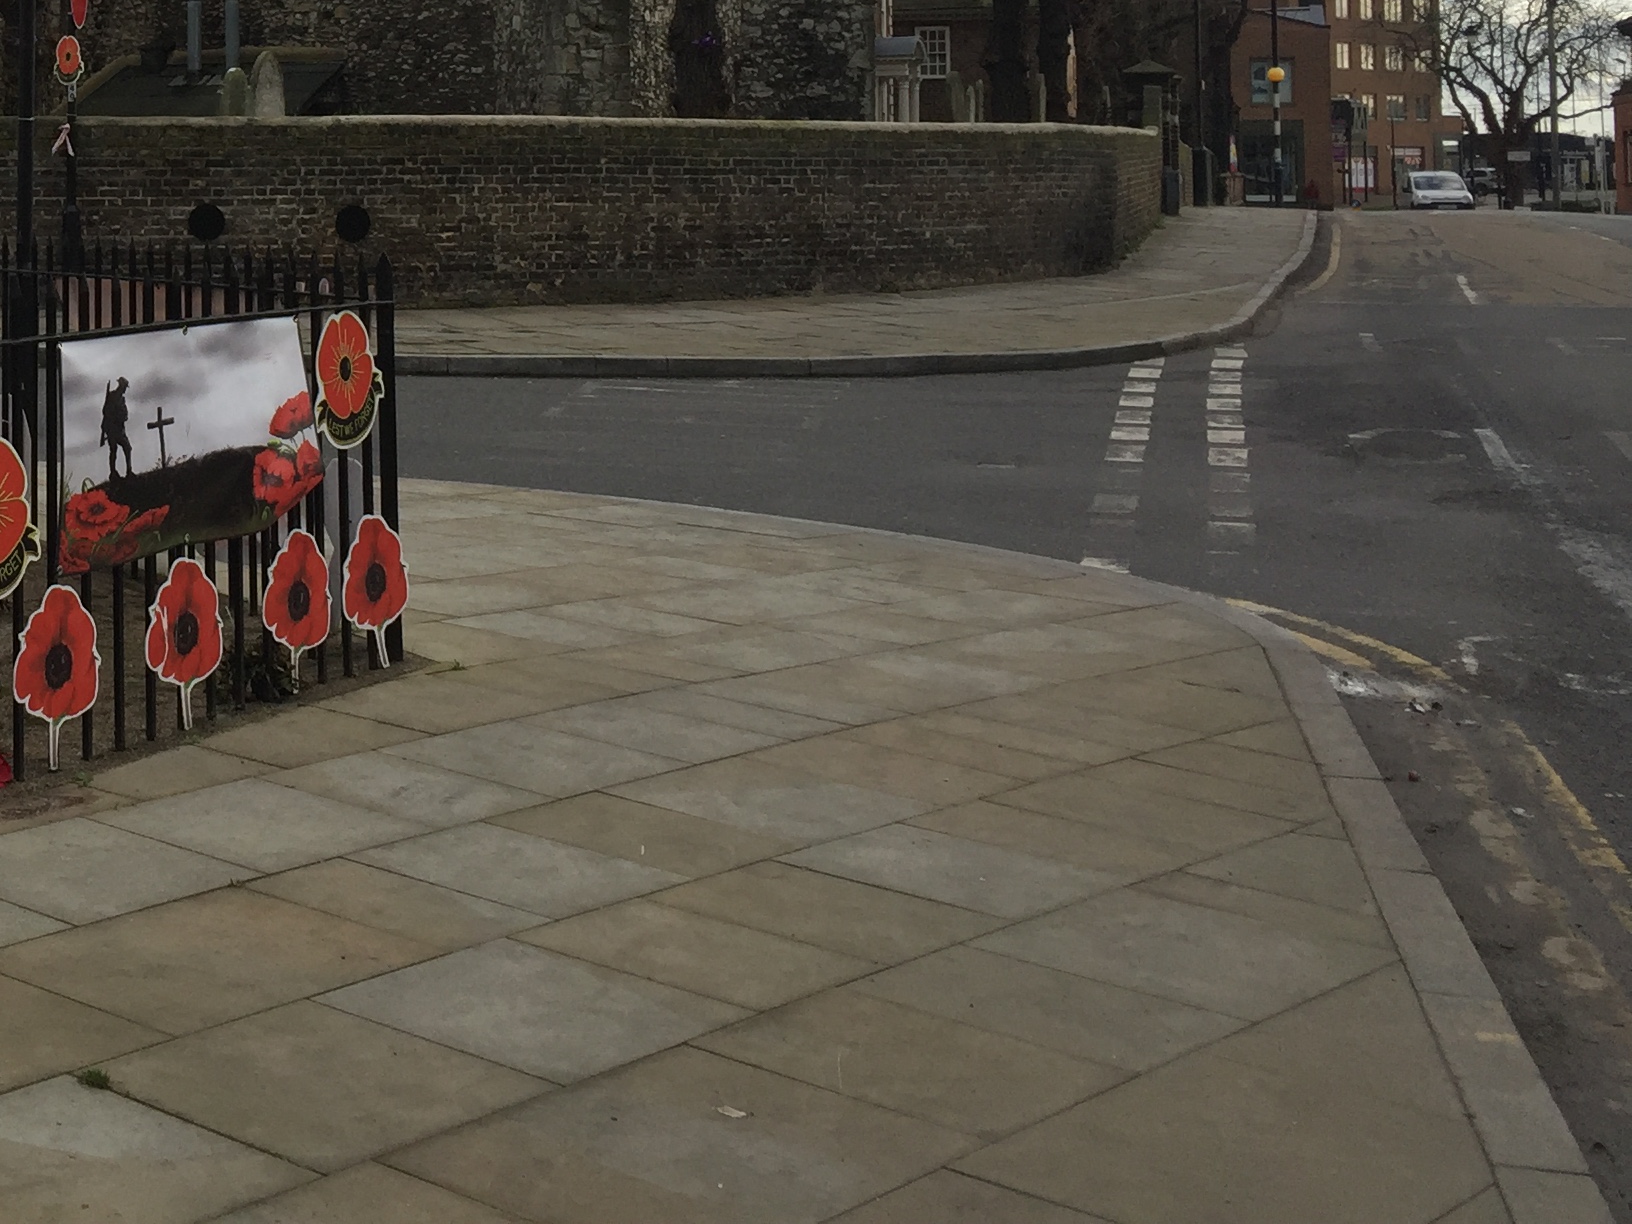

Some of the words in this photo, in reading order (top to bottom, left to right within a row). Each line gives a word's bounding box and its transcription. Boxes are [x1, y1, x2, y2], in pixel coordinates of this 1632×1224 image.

[328, 418, 344, 436] LEST
[344, 421, 354, 435] WE
[354, 395, 375, 431] FORGET
